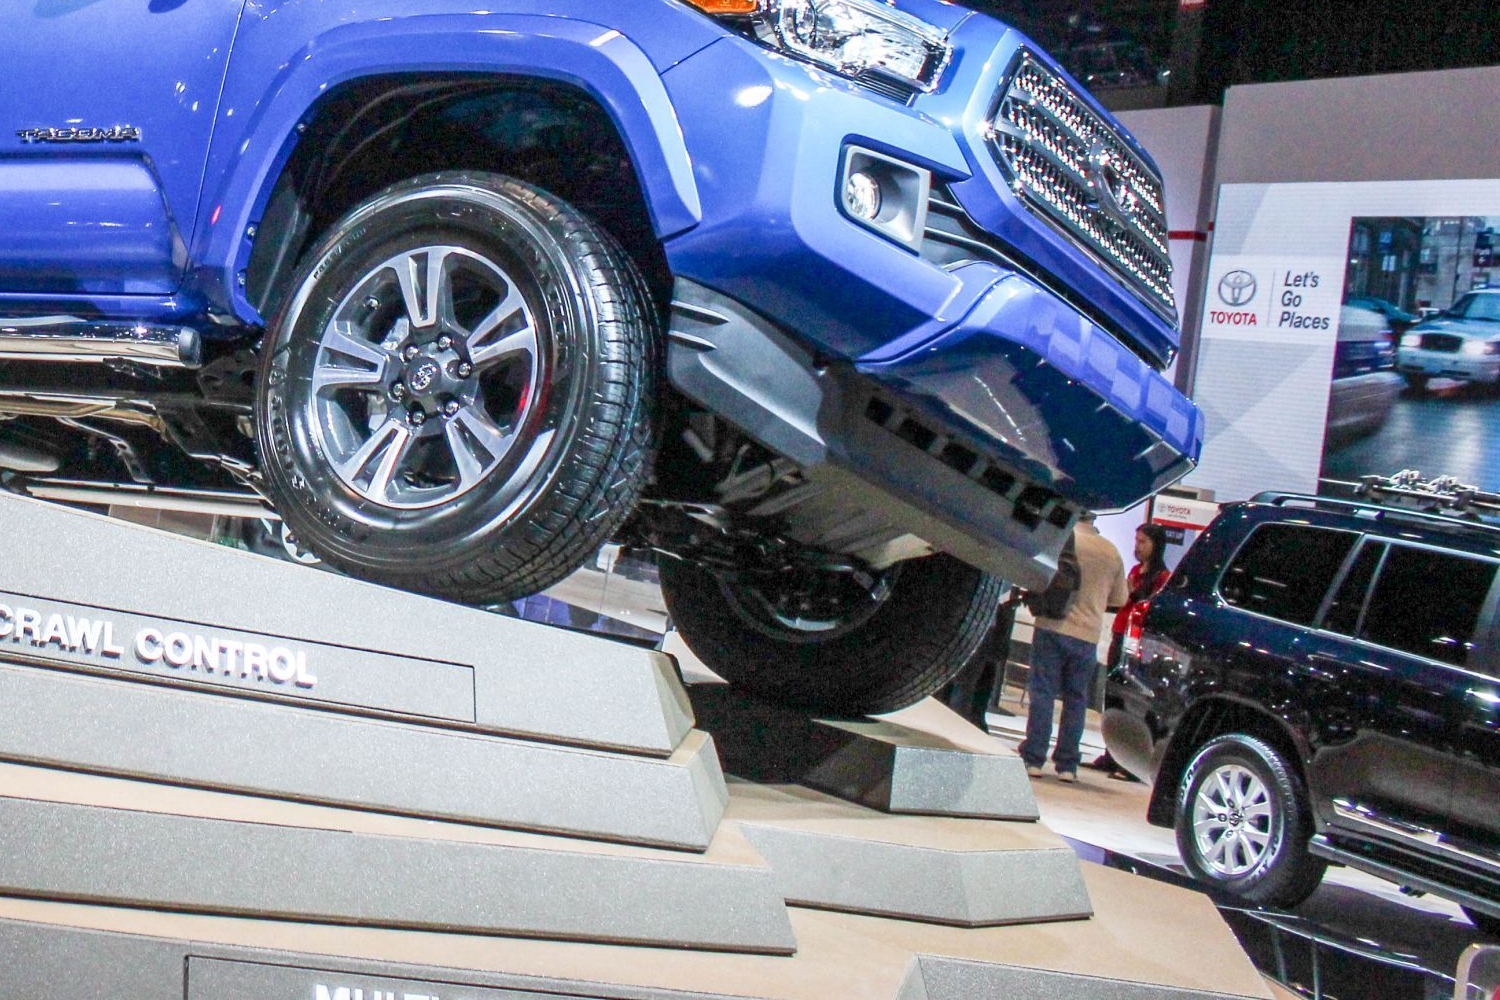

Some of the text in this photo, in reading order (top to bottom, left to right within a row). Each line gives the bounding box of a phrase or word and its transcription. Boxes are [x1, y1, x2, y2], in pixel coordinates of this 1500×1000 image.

[16, 125, 142, 143] TACOMA
[1284, 270, 1319, 288] Let's
[1281, 290, 1302, 307] Go
[1210, 311, 1257, 326] TOYOTA
[1279, 311, 1330, 330] Places
[1167, 505, 1191, 515] TOYOTA
[134, 628, 318, 688] CONTROL
